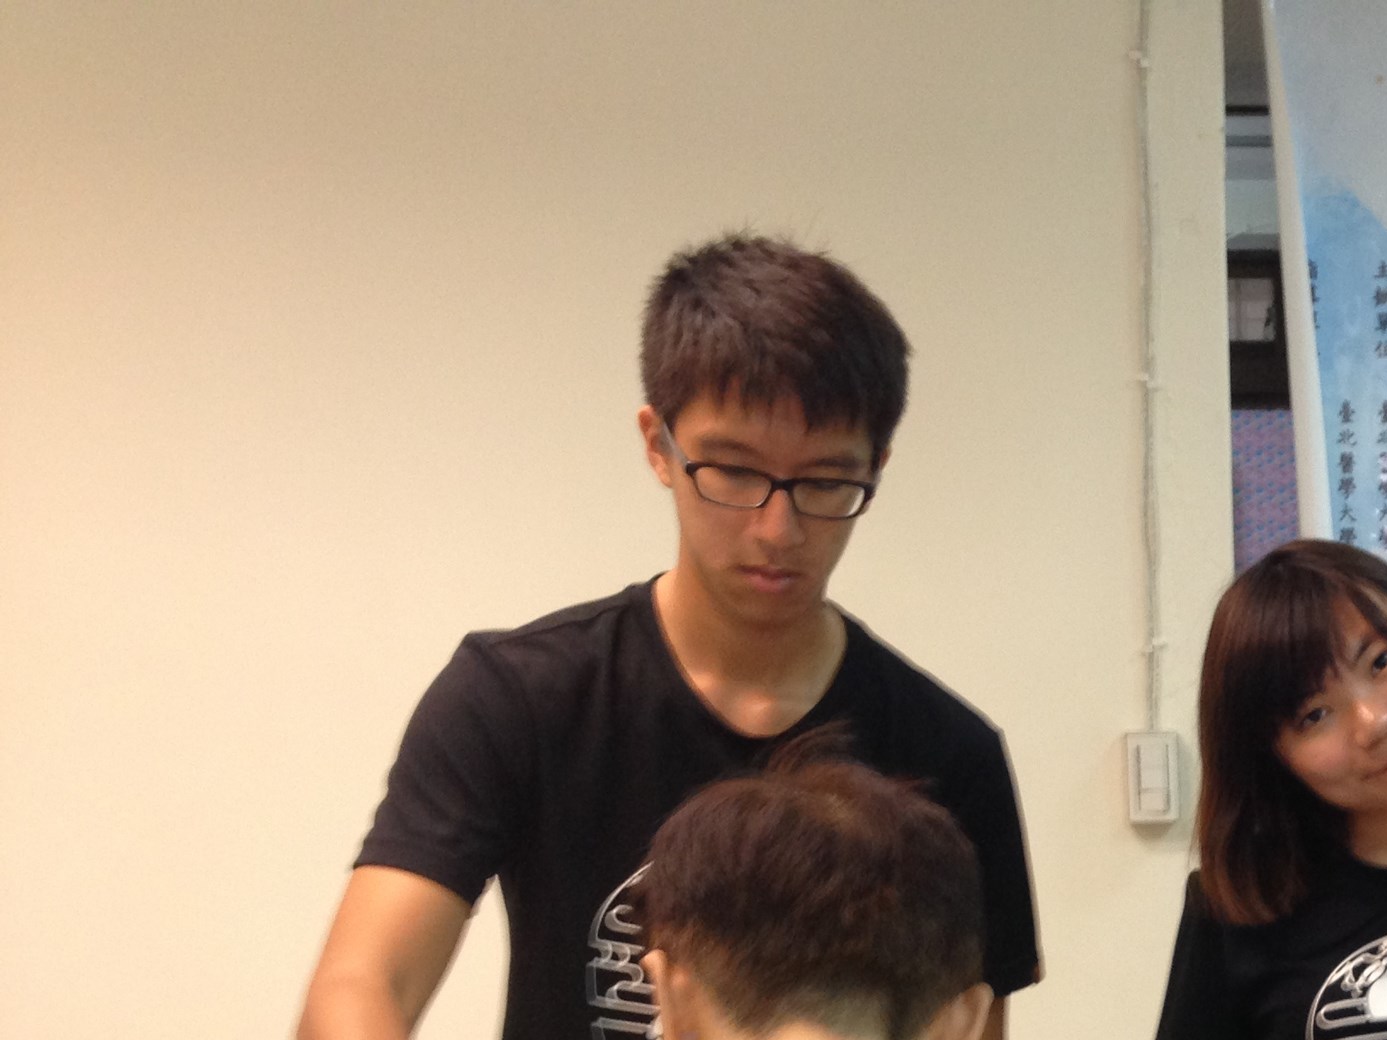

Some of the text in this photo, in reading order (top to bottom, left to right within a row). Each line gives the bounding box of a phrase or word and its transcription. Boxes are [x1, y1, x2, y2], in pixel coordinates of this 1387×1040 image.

[1337, 399, 1358, 544] 臺北醫學大學
